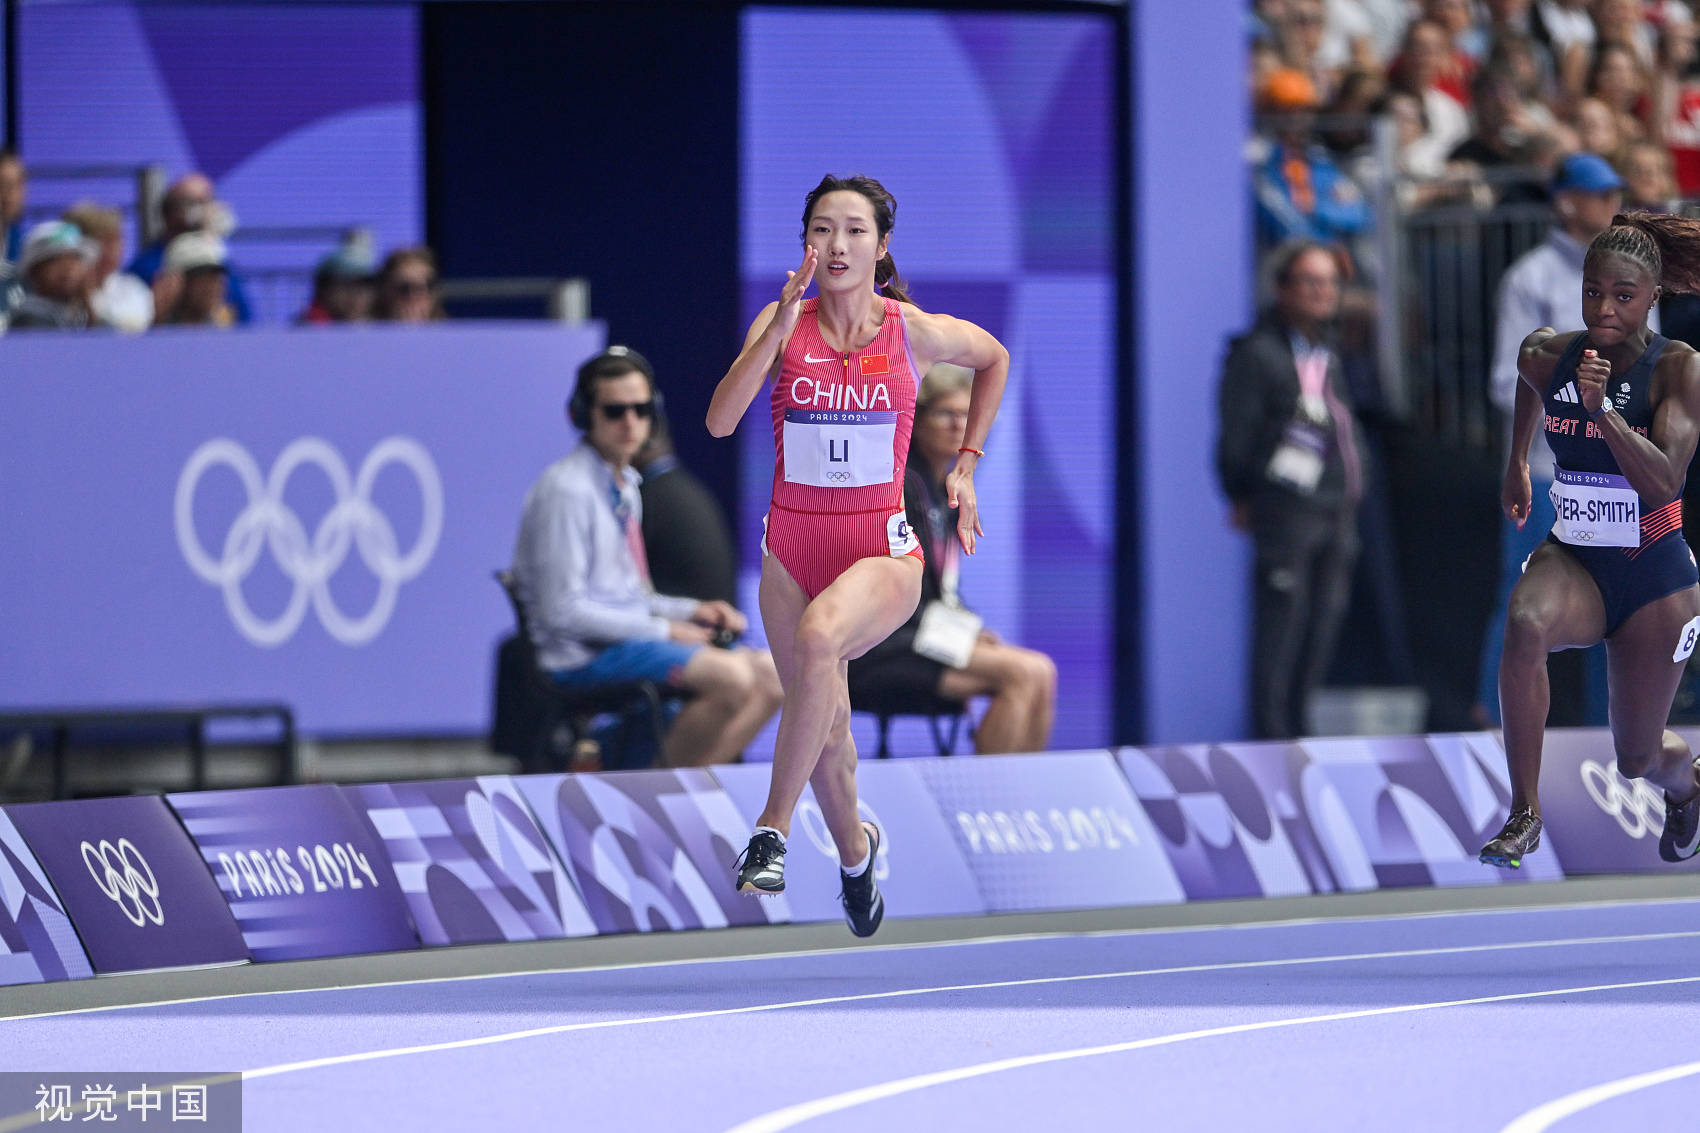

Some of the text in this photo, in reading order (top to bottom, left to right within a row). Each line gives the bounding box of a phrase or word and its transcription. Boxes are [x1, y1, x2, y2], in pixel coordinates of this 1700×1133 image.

[791, 376, 891, 410] CHINA
[841, 413, 868, 422] 2024
[1544, 414, 1580, 436] REAT
[829, 439, 849, 463] LI
[1585, 475, 1610, 484] 2024
[897, 520, 910, 545] 9
[1683, 627, 1695, 652] 8
[1048, 806, 1140, 851] 2024
[296, 842, 379, 893] 2024
